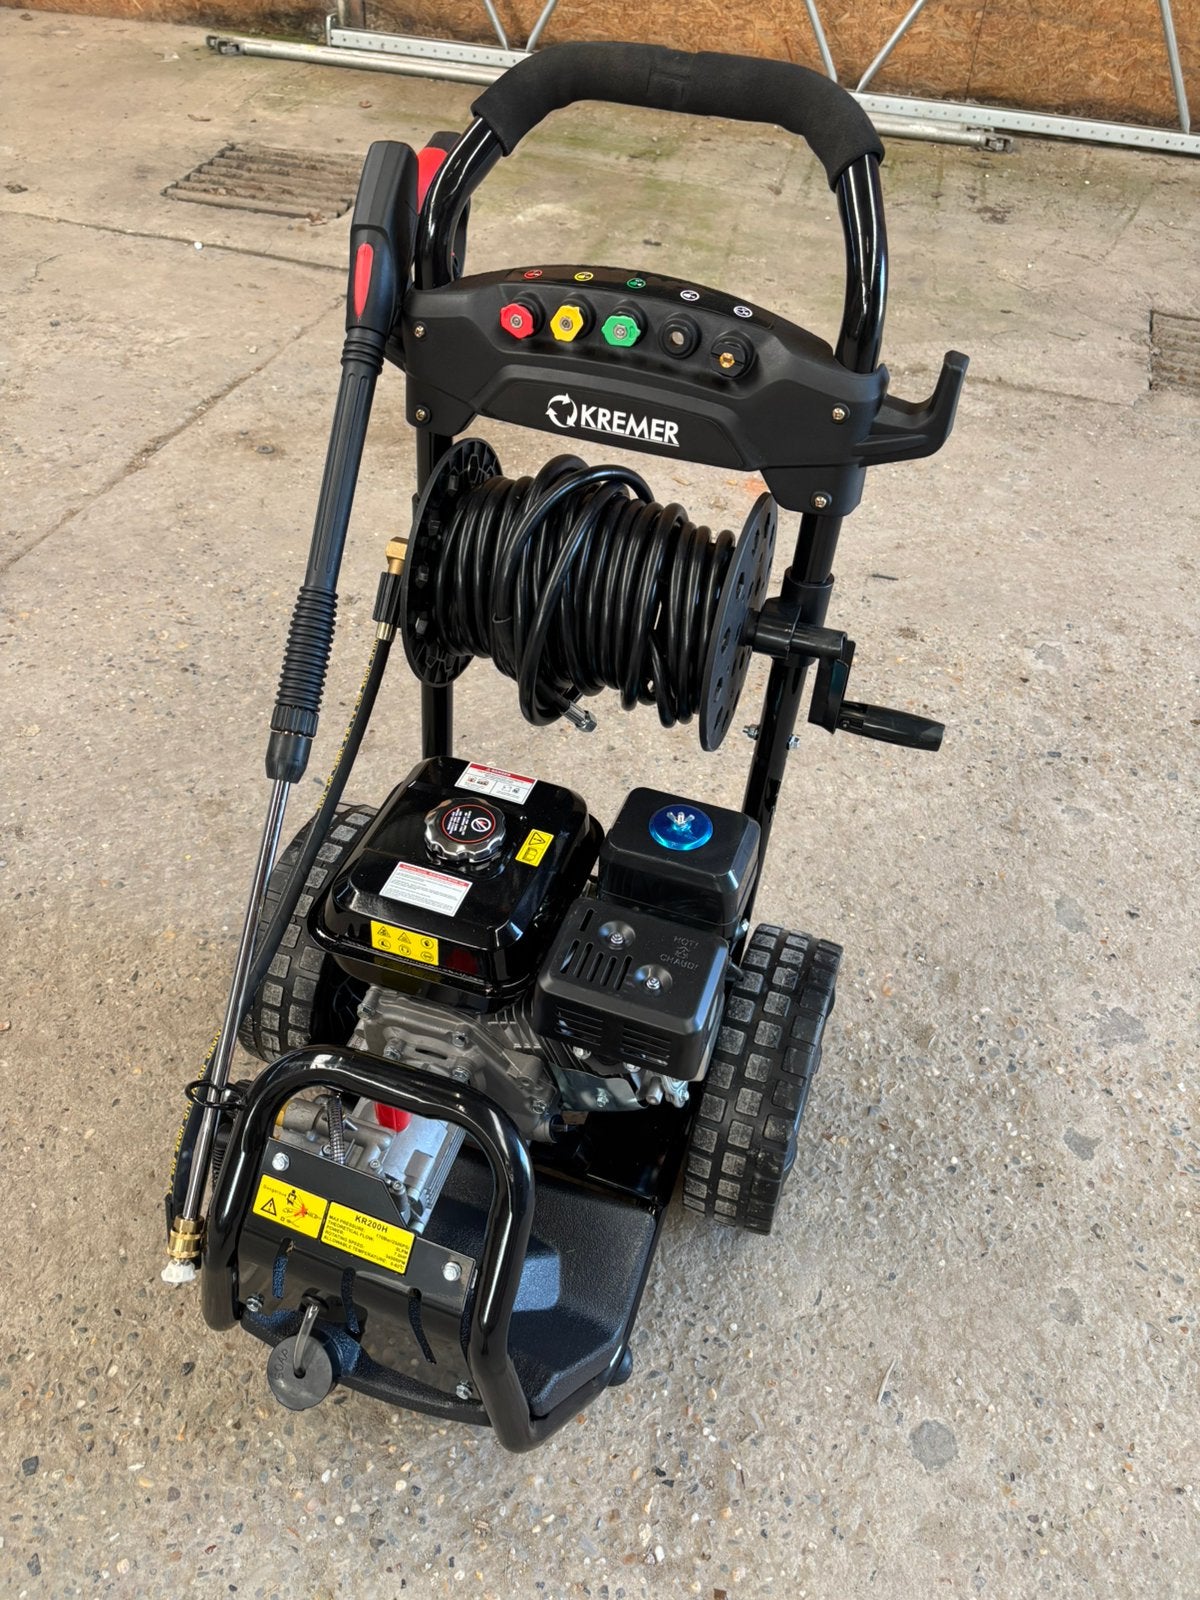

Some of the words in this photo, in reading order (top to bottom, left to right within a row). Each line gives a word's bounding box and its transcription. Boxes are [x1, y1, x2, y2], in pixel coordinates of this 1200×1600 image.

[580, 404, 680, 445] KREMER
[673, 935, 700, 950] HOT!
[659, 953, 700, 971] CHAUD!
[329, 1215, 339, 1223] MAX
[354, 1214, 389, 1234] KR200H
[325, 1230, 348, 1244] ROTATING
[326, 1225, 344, 1236] POWER:
[328, 1220, 359, 1238] THEORETICAL
[324, 1235, 352, 1249] ALLOWABLE
[273, 1348, 288, 1380] SOAP
